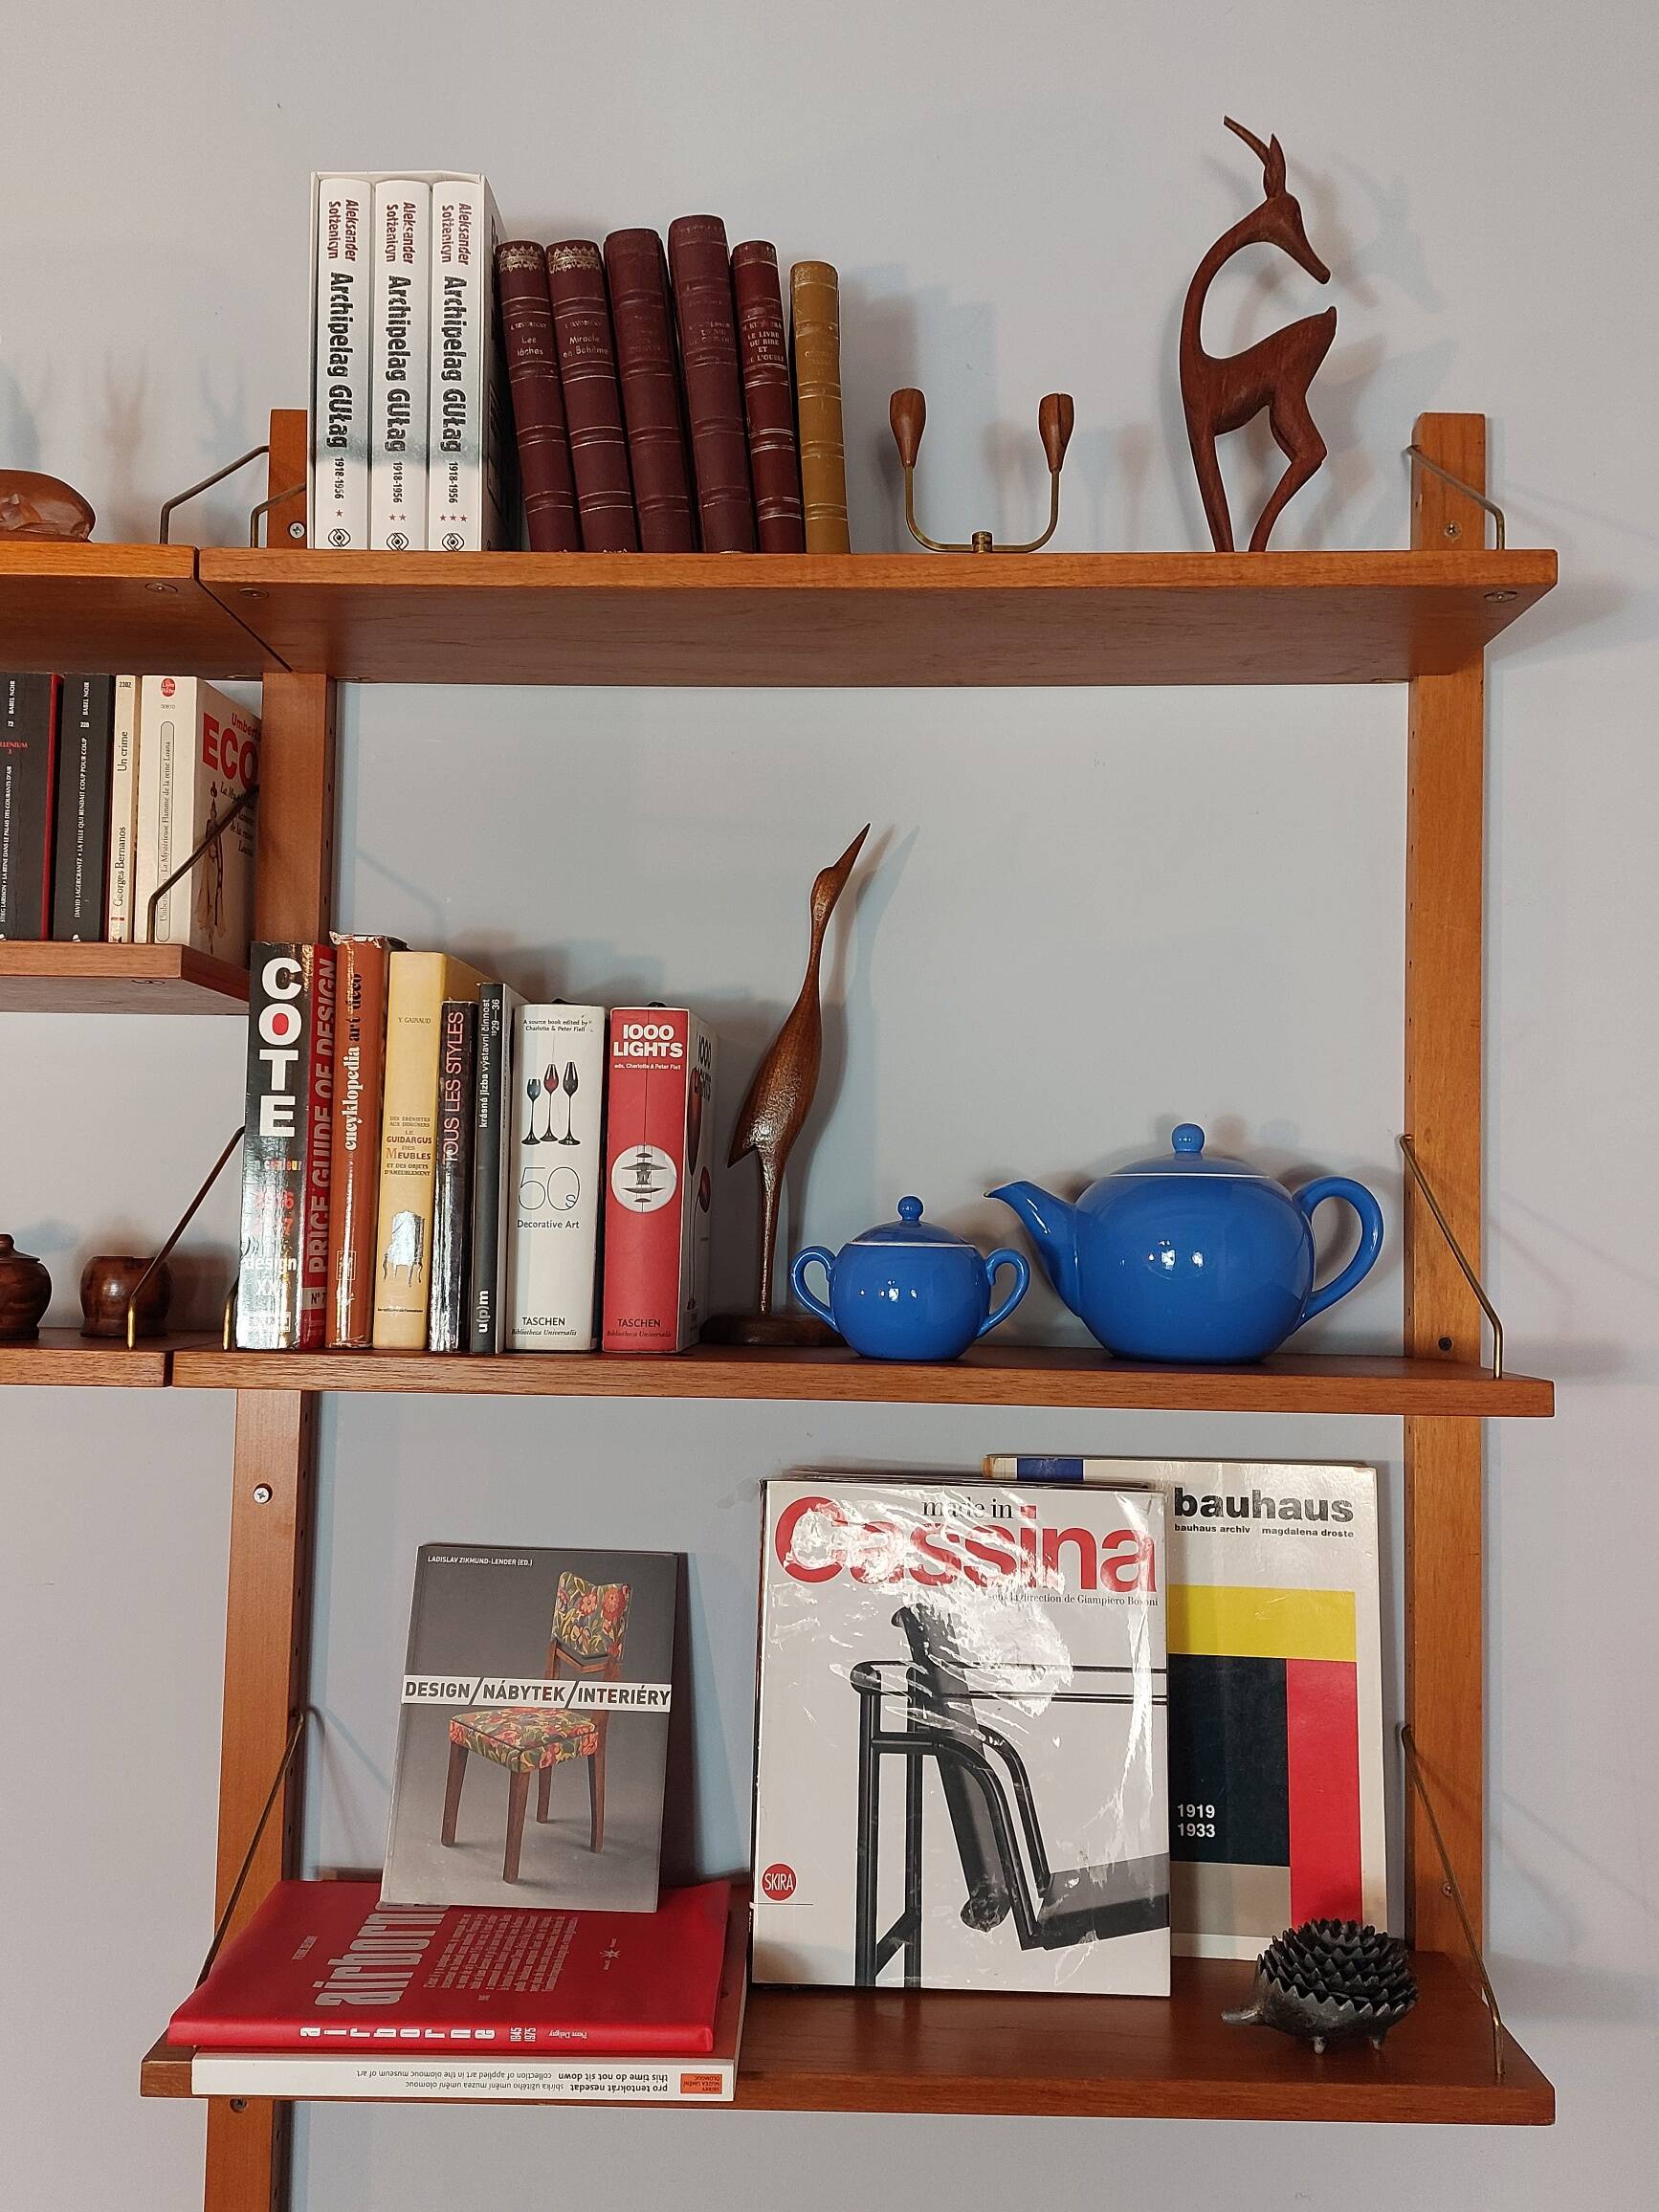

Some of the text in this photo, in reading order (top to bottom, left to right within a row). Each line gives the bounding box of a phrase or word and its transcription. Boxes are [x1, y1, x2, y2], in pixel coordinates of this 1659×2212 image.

[344, 199, 359, 262] Aleksander
[402, 202, 416, 264] Aleksander
[457, 202, 472, 266] Aleksander
[327, 272, 354, 377] Archipelag
[386, 275, 411, 382] Archipelag
[441, 276, 467, 382] Archipelag
[569, 335, 600, 345] Miracle
[334, 456, 344, 499] 1918-1956
[392, 461, 403, 503] 1918-1956
[448, 461, 458, 503] 1918-1956
[118, 732, 127, 771] Un crime
[203, 712, 258, 791] ECO
[113, 827, 125, 907] Georges Bernanos
[346, 1018, 361, 1042] art
[623, 1024, 675, 1041] 1000
[258, 958, 302, 1138] COTE
[613, 1041, 683, 1058] LIGHTS
[443, 1011, 464, 1164] TOUS LES STYLES
[479, 1073, 491, 1096] jizba
[342, 1047, 363, 1151] encyklopedia
[309, 958, 335, 1273] PRICE GUIDE OF DESIGN
[479, 1097, 489, 1128] krásná
[387, 1136, 432, 1144] GUIDARGUS
[386, 1147, 431, 1161] MEUBLES
[517, 1219, 580, 1228] Decorative Art
[476, 1290, 491, 1334] u(p)m
[521, 1316, 565, 1326] TASCHEN
[617, 1318, 661, 1327] TASCHEN
[991, 1498, 1013, 1518] in
[1174, 1487, 1354, 1523] bauhaus
[1175, 1523, 1354, 1537] bauhaus archiv magdalena droste
[459, 1557, 517, 1565] ZIKMUND-LENDER
[1064, 1594, 1075, 1604] de
[1077, 1595, 1125, 1606] Giampiero
[1177, 1803, 1216, 1819] 1919
[1177, 1823, 1216, 1838] 1933
[764, 1873, 794, 1891] SKIRA
[510, 2027, 521, 2042] 1945
[524, 2027, 536, 2042] 1975
[478, 2071, 505, 2080] applied
[517, 2071, 552, 2080] collection
[558, 2072, 583, 2081] down
[615, 2073, 626, 2082] do
[652, 2074, 668, 2083] this
[406, 2081, 437, 2090] olomouc
[513, 2083, 538, 2091] užitého
[541, 2083, 564, 2091] sbírka
[570, 2083, 607, 2092] nesedat
[608, 2083, 652, 2093] tentokrát
[653, 2083, 668, 2091] pro
